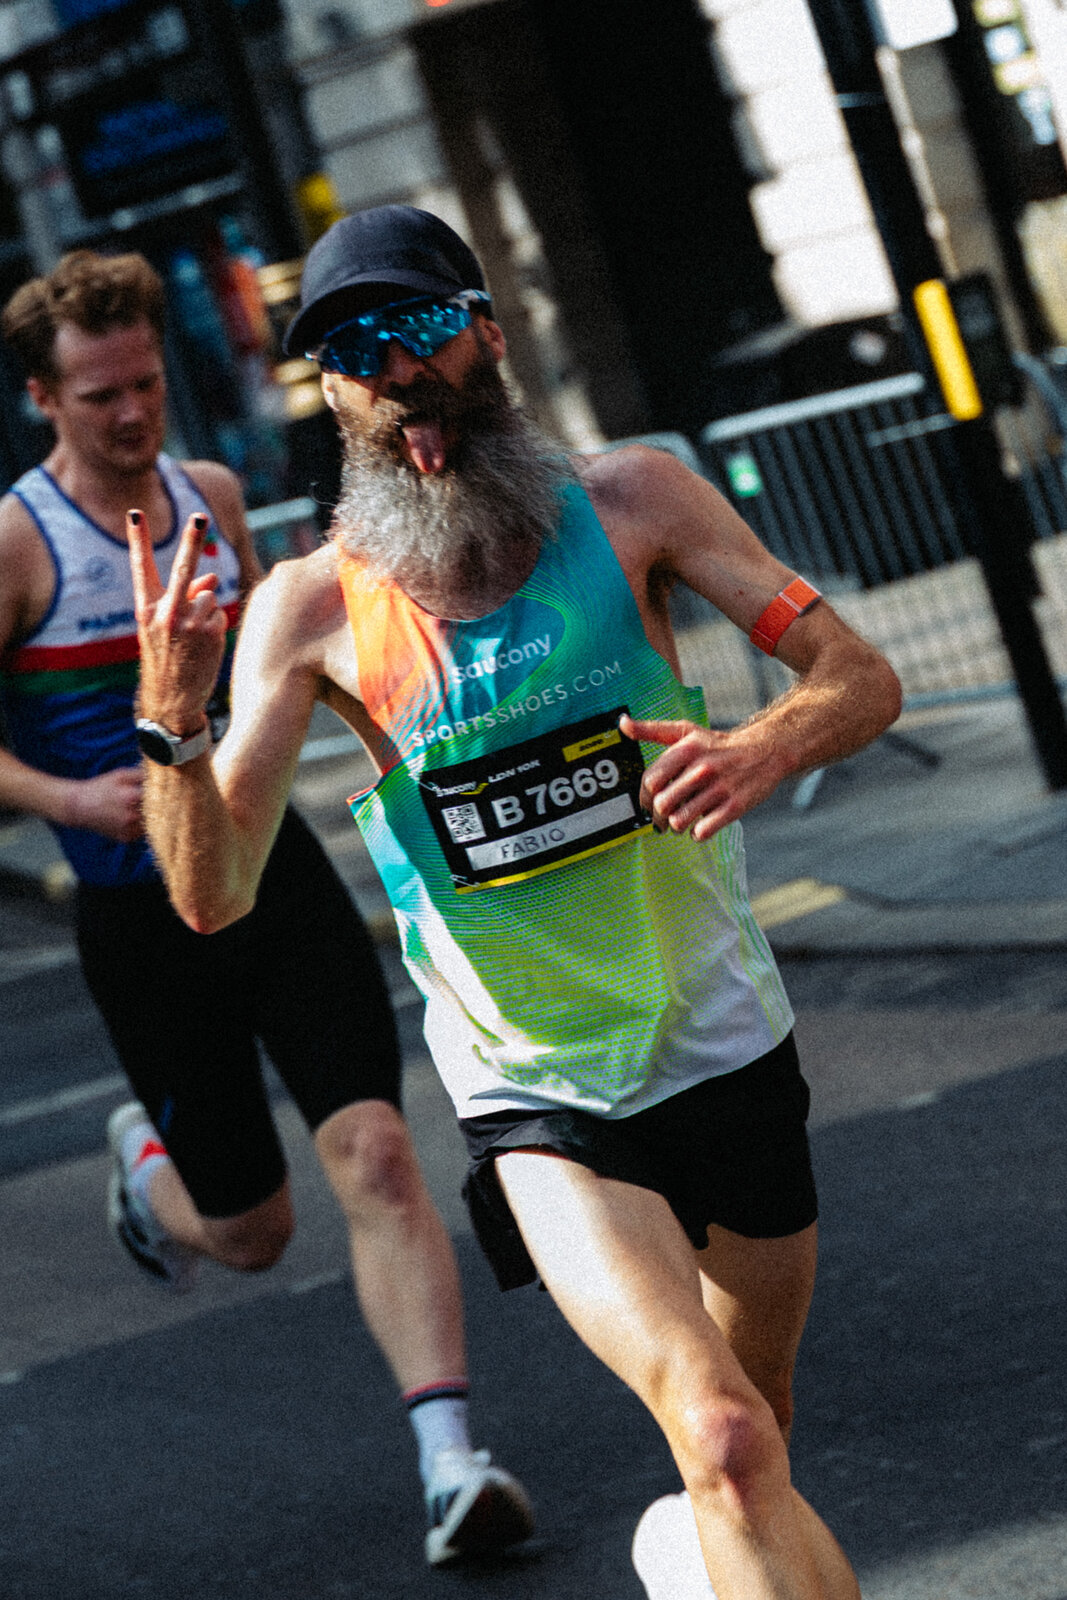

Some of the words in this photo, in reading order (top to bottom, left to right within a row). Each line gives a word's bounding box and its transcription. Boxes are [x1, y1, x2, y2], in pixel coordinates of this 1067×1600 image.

[450, 634, 550, 684] saucony
[411, 660, 622, 747] SPORTSSHOES.COM
[491, 795, 525, 828] B
[525, 759, 620, 815] 7669
[500, 828, 566, 859] FABIO
